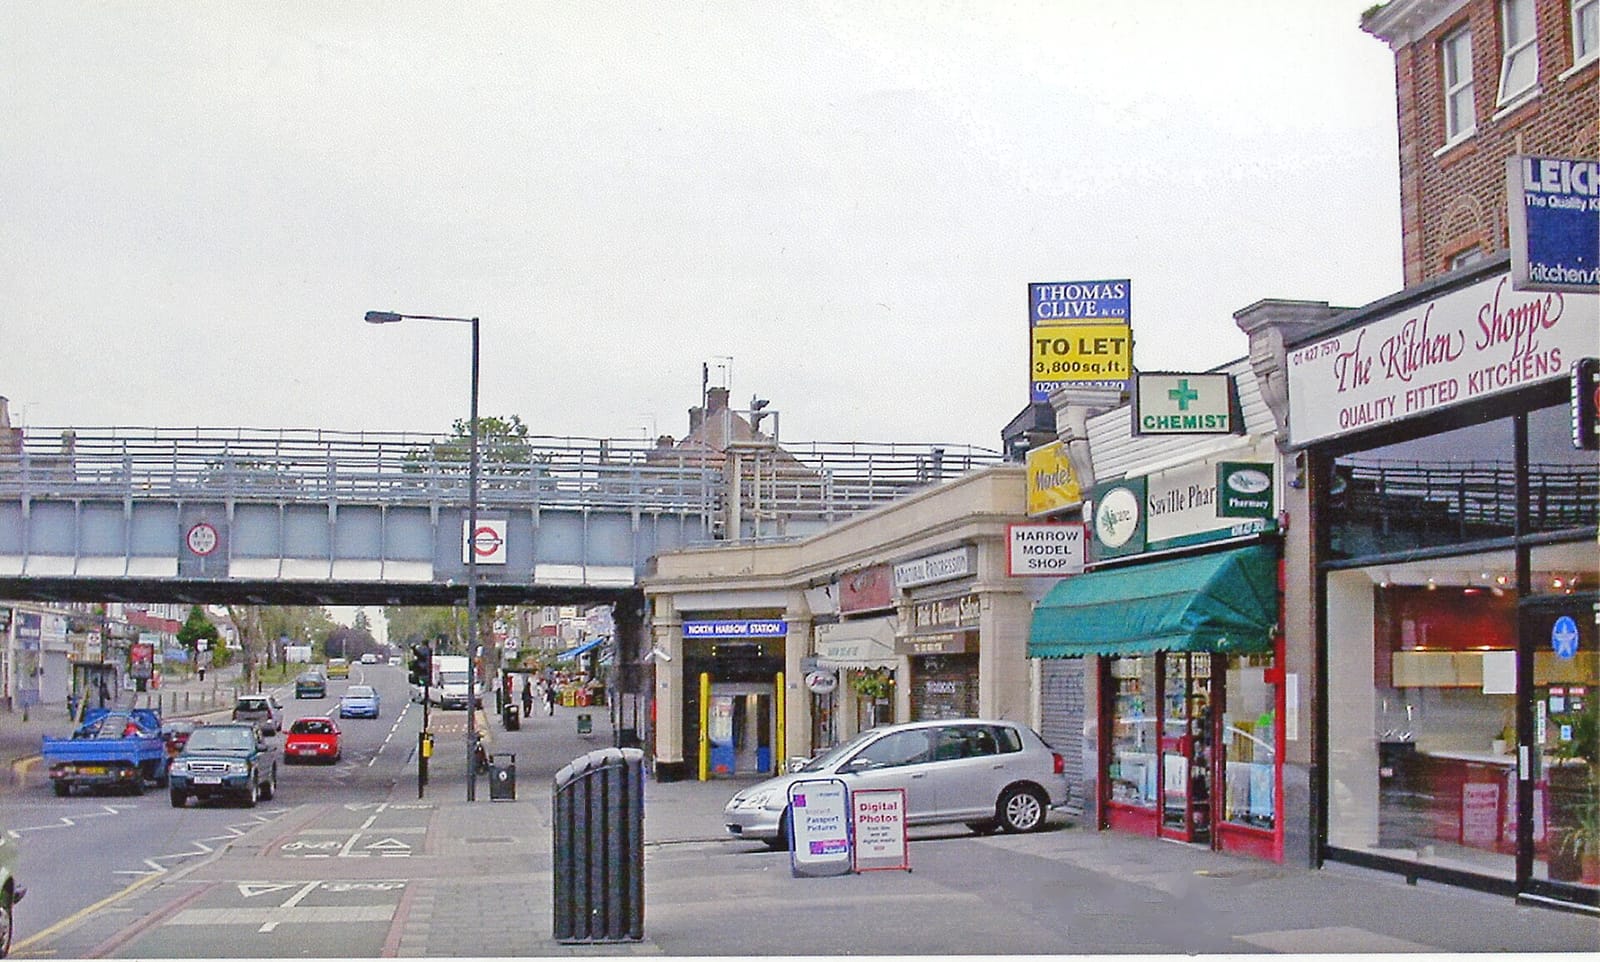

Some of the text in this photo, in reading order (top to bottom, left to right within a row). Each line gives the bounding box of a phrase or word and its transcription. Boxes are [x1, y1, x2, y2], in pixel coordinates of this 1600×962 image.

[1526, 195, 1546, 207] The
[1548, 195, 1586, 212] Quality
[1036, 284, 1125, 301] THOMAS
[1037, 301, 1098, 318] CLIVE
[1111, 308, 1125, 316] CO
[1334, 276, 1564, 393] The Kitchen Shoppe
[1036, 338, 1126, 356] TO LET
[1304, 345, 1318, 361] 427
[1339, 347, 1562, 429] QUALITY FITTED KITCHENS
[1143, 414, 1228, 430] CHEMIST
[1149, 484, 1216, 518] Saville Phar
[1229, 497, 1269, 510] Pharmacy
[1015, 530, 1079, 541] HARROW
[1023, 545, 1072, 555] MODEL
[1028, 558, 1067, 569] SHOP
[688, 623, 780, 634] NORTH HARROW STATION
[860, 801, 898, 814] Digital
[860, 814, 898, 823] Photos
